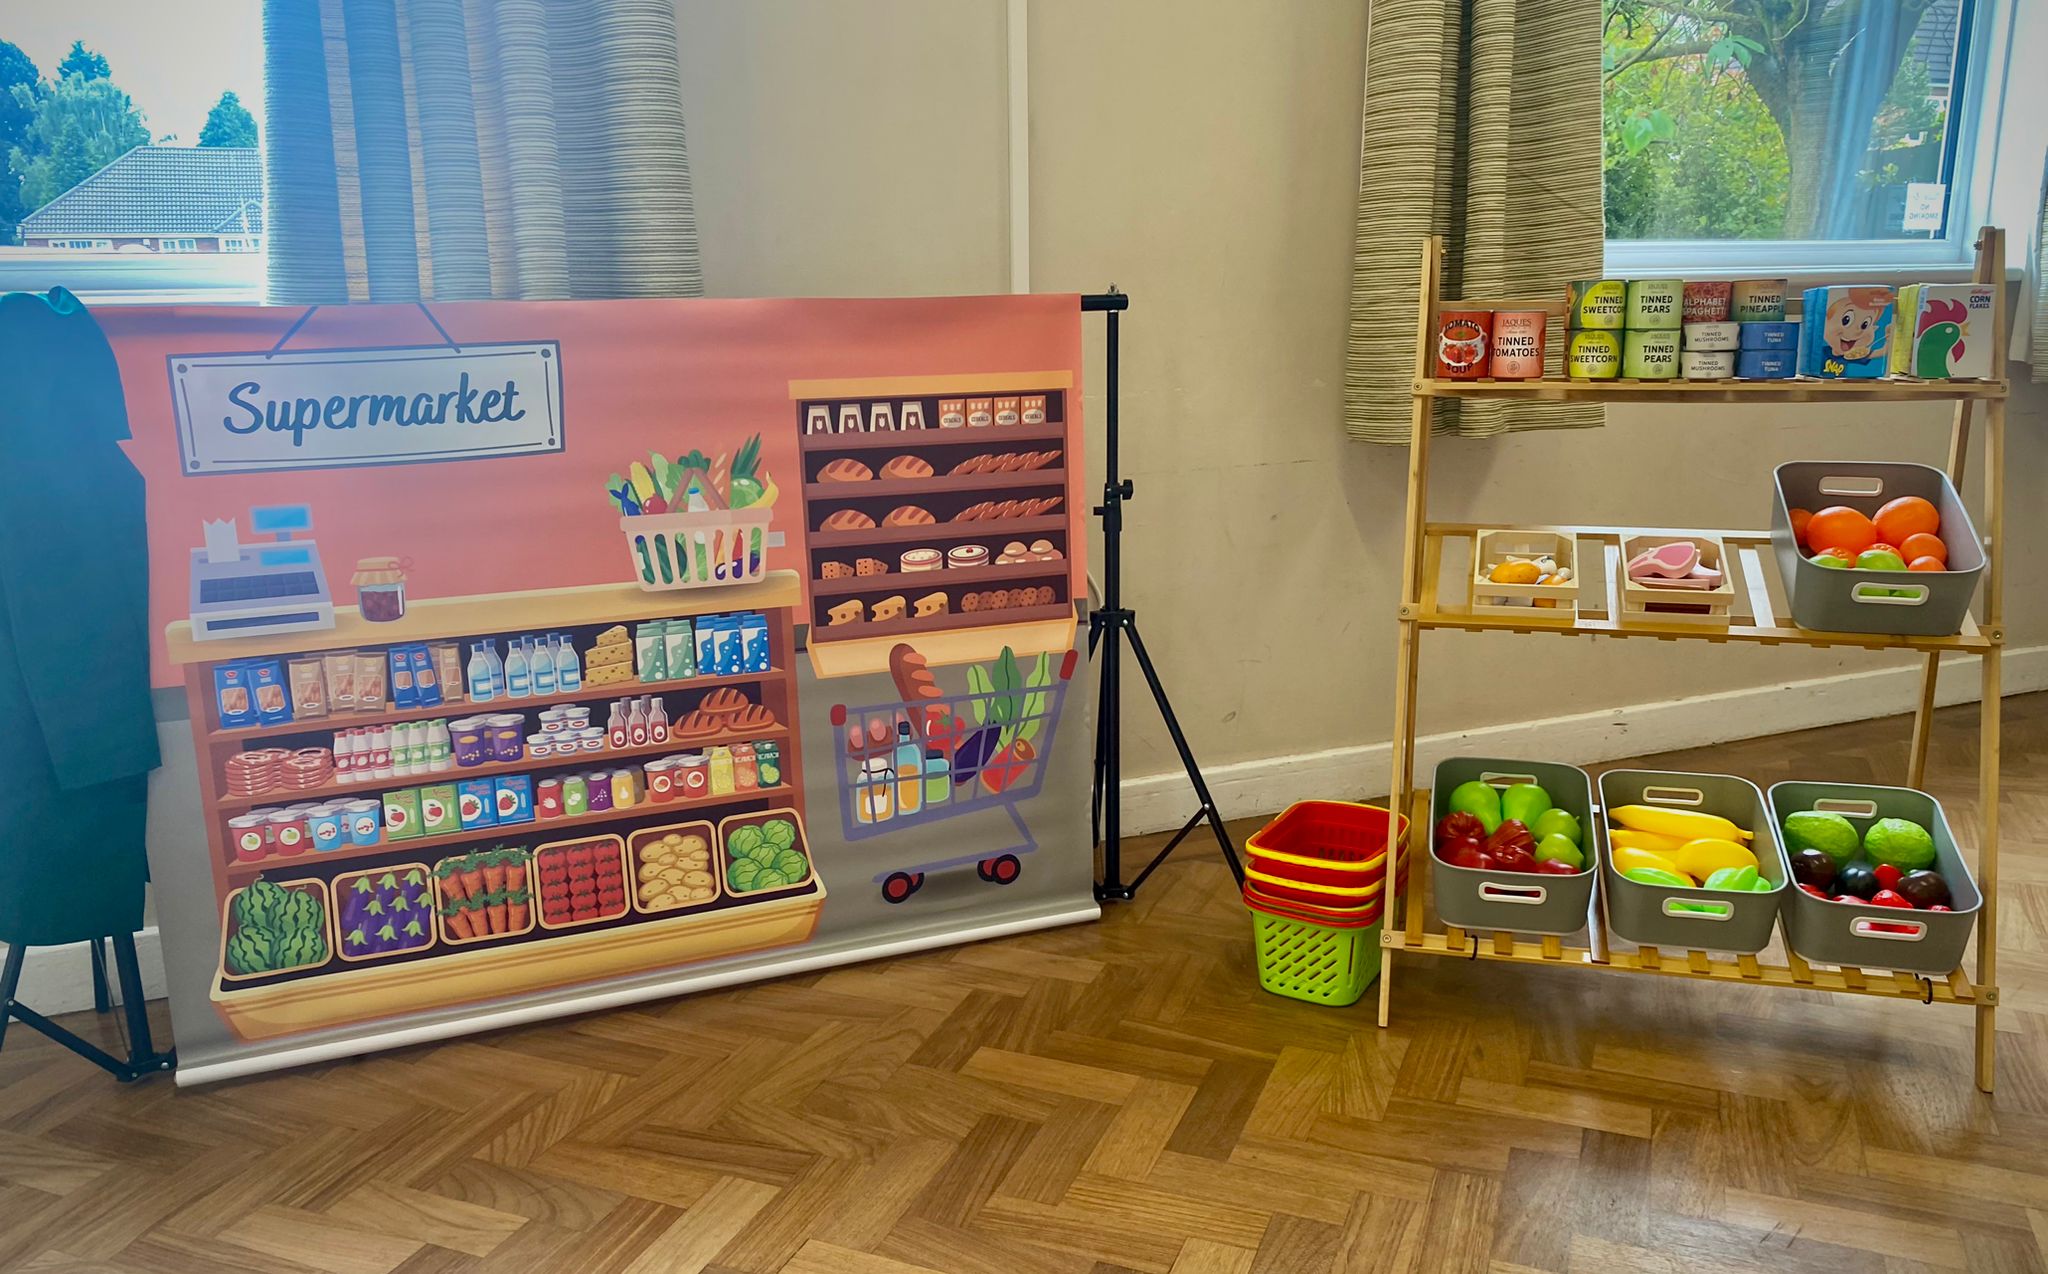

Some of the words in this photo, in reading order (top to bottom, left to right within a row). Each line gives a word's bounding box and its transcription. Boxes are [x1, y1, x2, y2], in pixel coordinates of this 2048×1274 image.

[1594, 296, 1623, 304] TINNED
[1640, 295, 1673, 304] TINNED
[1749, 295, 1781, 304] TINNED
[1969, 295, 1991, 303] CORN
[1641, 305, 1671, 313] PEARS
[1445, 319, 1480, 333] TOMATO
[1501, 318, 1532, 328] JAQUES
[1498, 336, 1534, 346] TINNED
[1493, 347, 1540, 357] TOMATOES
[1578, 345, 1610, 353] TINNED
[1643, 345, 1674, 353] TINNED
[1570, 355, 1617, 363] SWEETCORN
[1644, 355, 1672, 363] PEARS
[1446, 362, 1474, 374] SOUP
[223, 372, 526, 447] Supermarket
